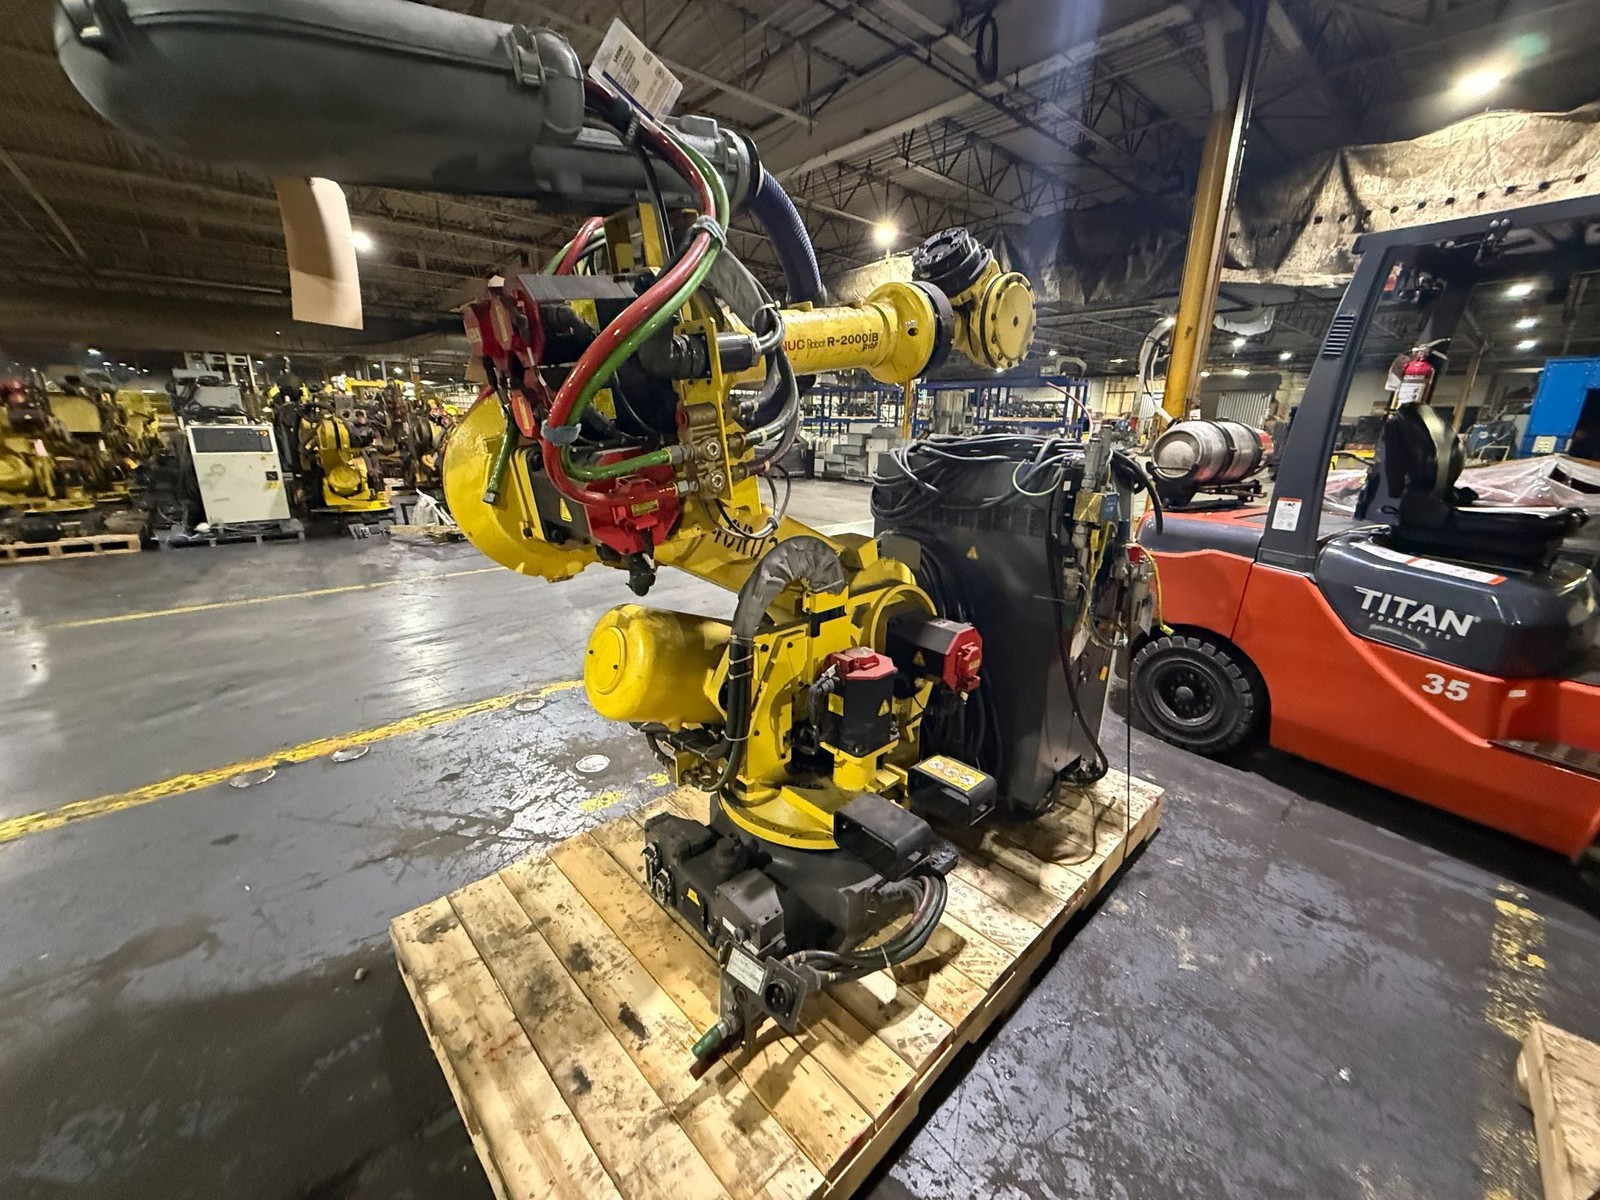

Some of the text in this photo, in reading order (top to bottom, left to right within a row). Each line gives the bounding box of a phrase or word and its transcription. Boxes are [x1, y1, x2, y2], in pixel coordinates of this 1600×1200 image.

[781, 339, 805, 352] NUC
[827, 329, 879, 347] R-2000iB
[1354, 585, 1475, 637] TITAN
[1368, 612, 1452, 640] FORKLIFTS
[1421, 673, 1471, 701] 35
